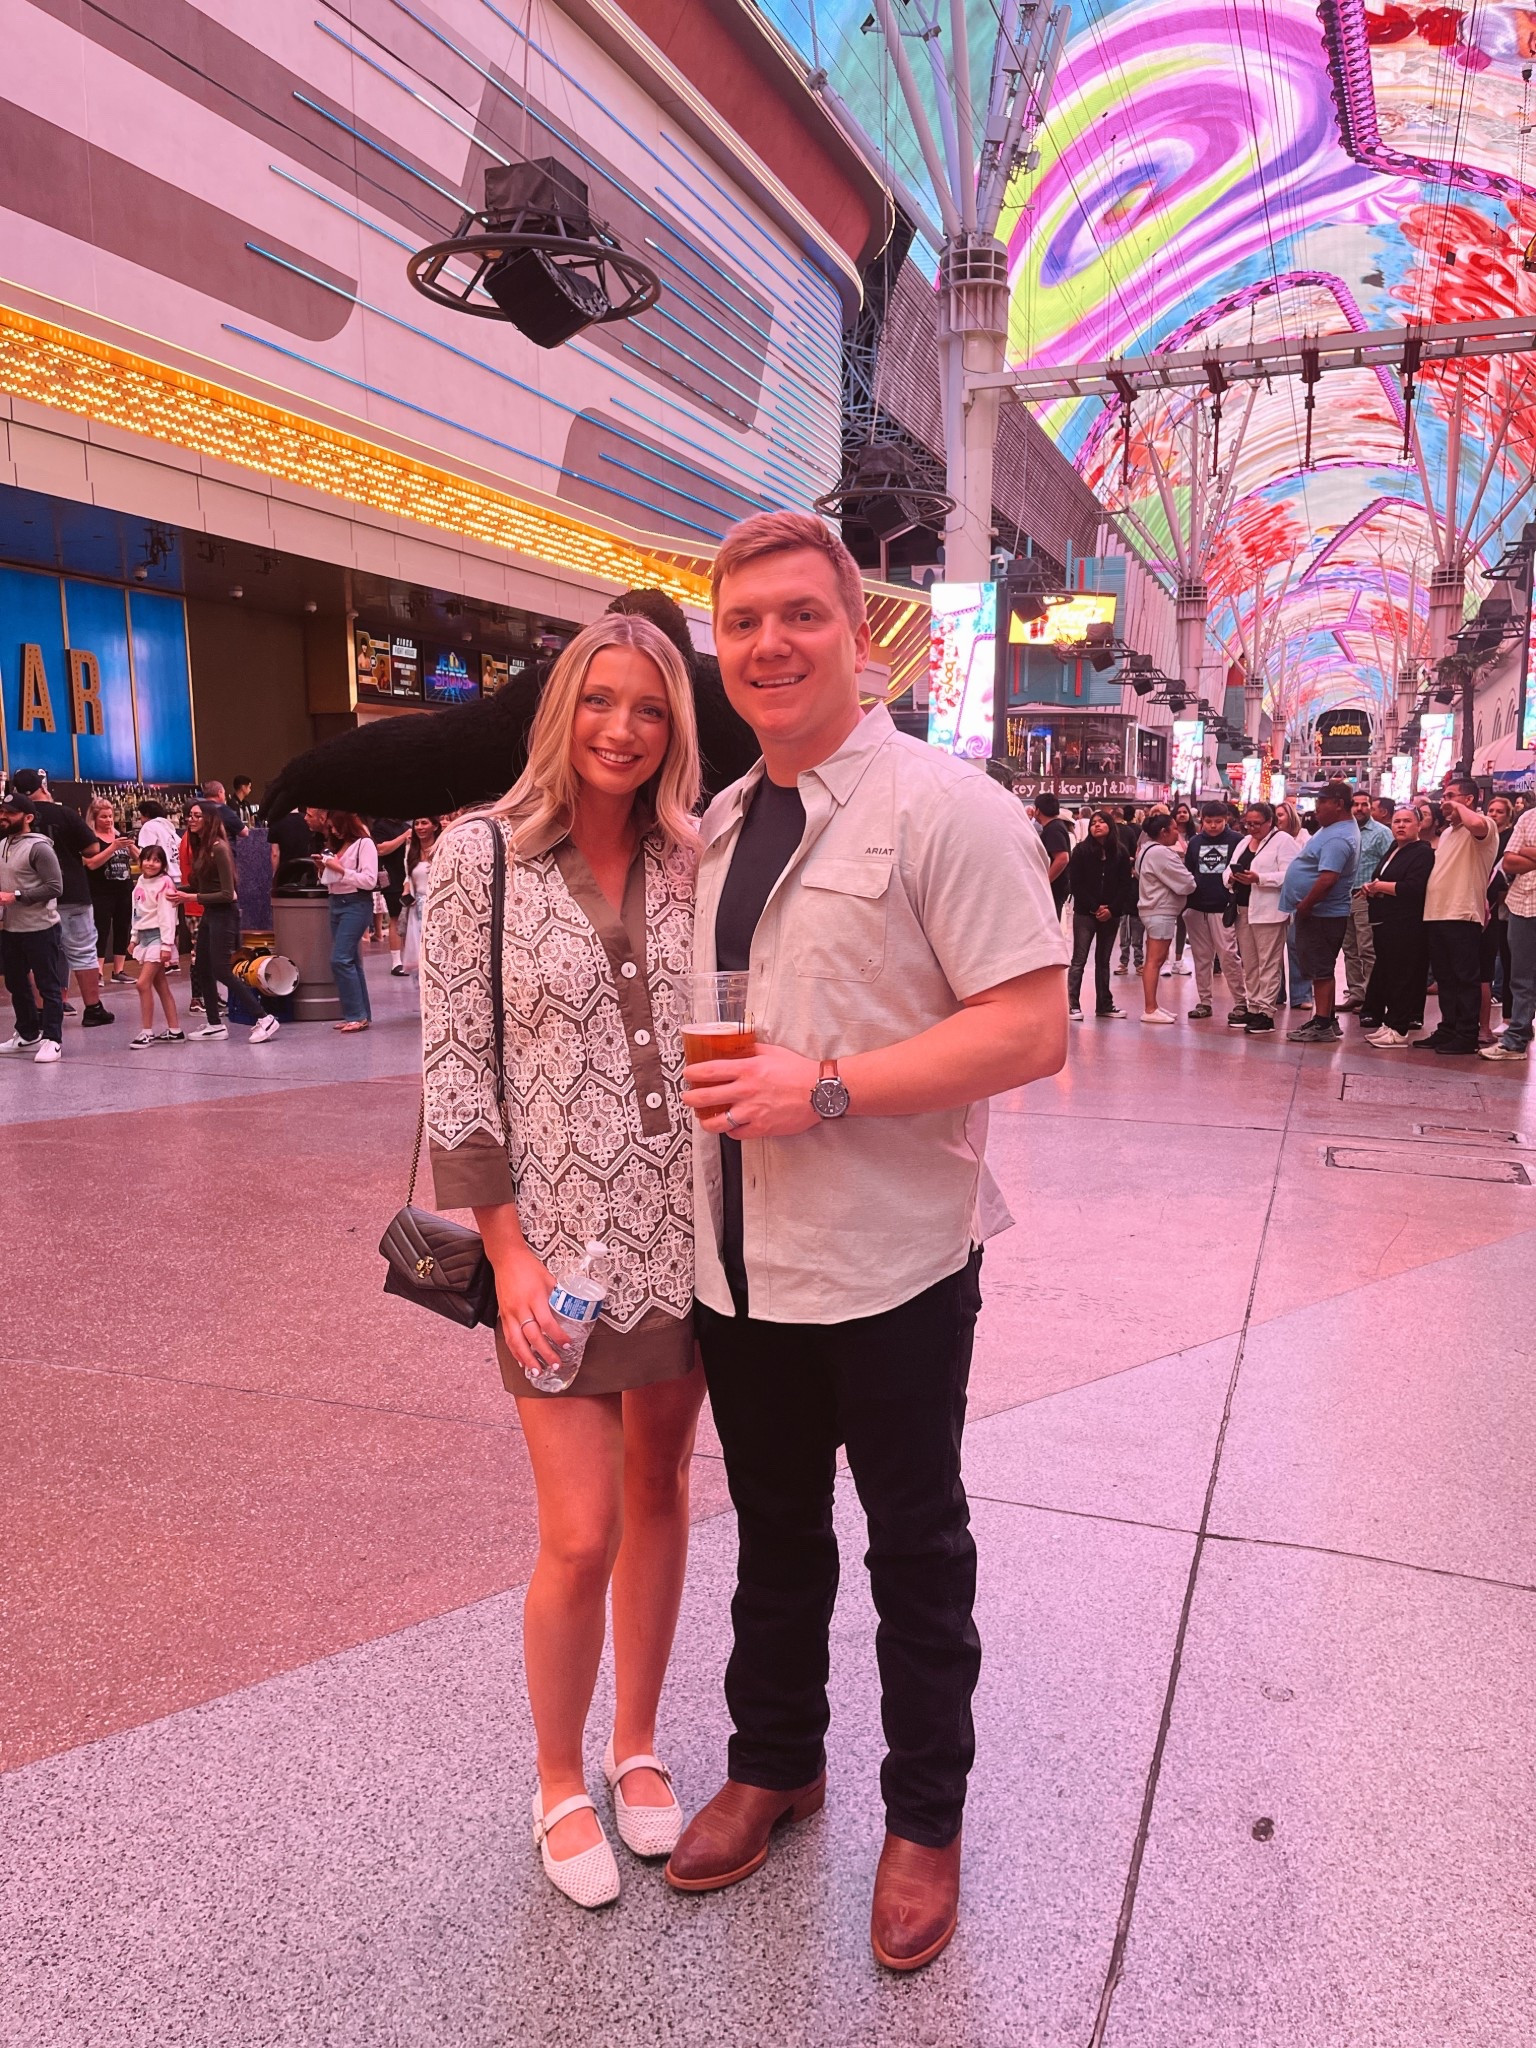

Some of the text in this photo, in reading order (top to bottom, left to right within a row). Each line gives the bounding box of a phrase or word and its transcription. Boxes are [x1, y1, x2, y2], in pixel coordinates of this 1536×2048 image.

[436, 653, 467, 673] JELLO
[940, 661, 956, 694] boys
[1039, 780, 1083, 796] Liker
[1085, 781, 1102, 797] Up
[1109, 780, 1118, 794] &
[865, 847, 894, 856] ARIAT
